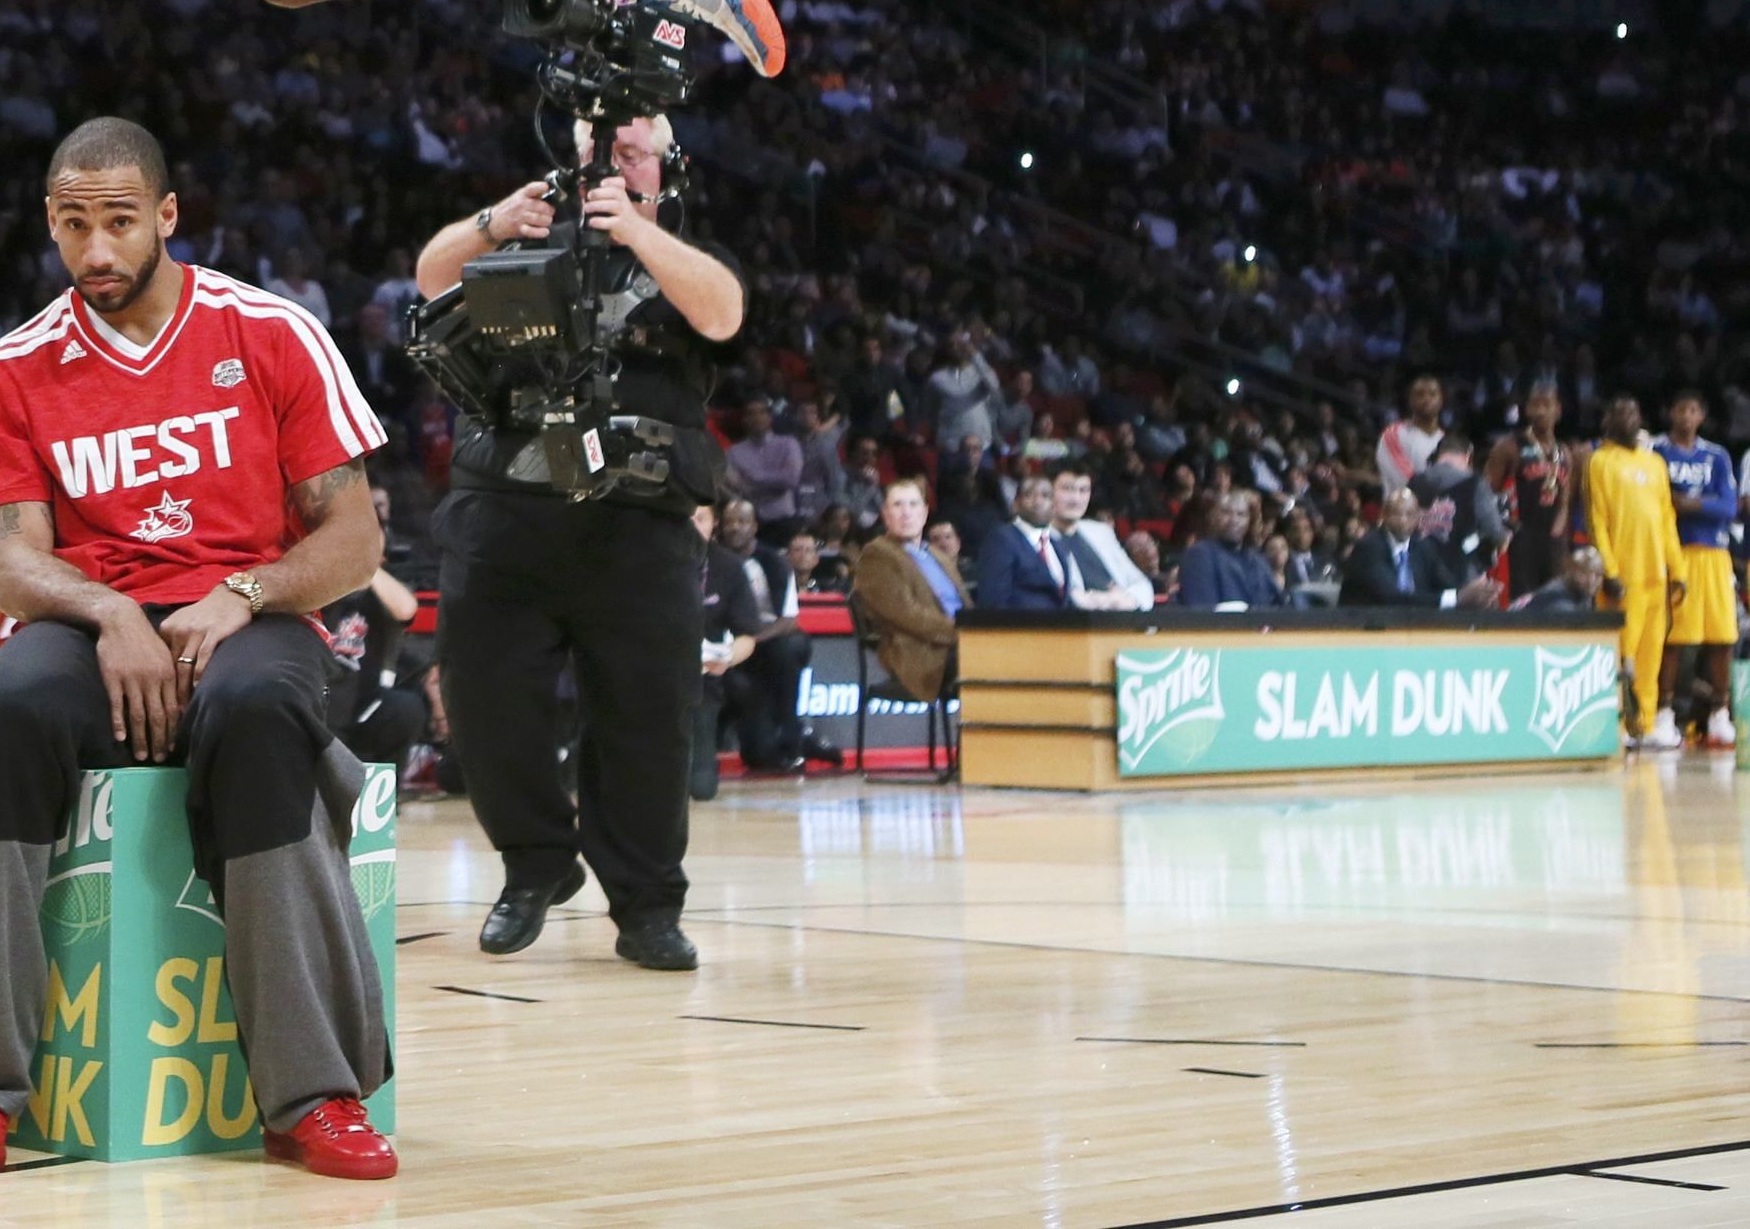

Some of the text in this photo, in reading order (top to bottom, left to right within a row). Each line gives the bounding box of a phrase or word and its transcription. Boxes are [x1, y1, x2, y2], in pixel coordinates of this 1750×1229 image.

[654, 20, 685, 49] AVS
[51, 406, 240, 499] WEST
[1118, 647, 1211, 748] Sprite
[1254, 668, 1510, 741] SLAM DUNK
[1540, 645, 1616, 734] Sprite
[147, 956, 238, 1047] SL
[10, 1054, 103, 1147] NK
[142, 1053, 259, 1146] DU
